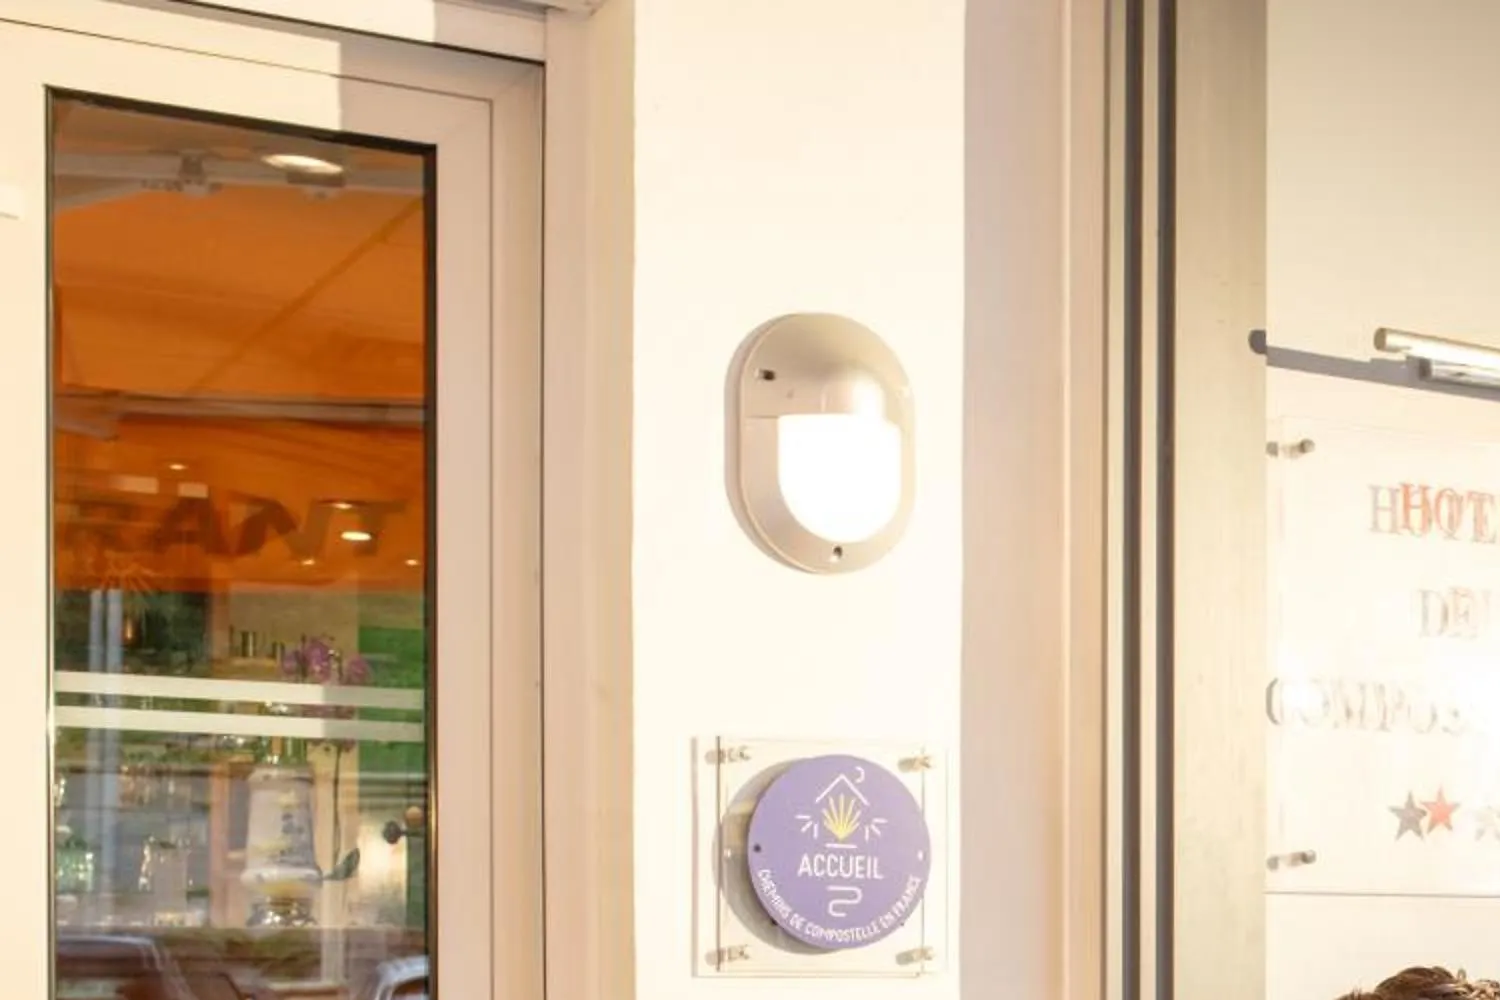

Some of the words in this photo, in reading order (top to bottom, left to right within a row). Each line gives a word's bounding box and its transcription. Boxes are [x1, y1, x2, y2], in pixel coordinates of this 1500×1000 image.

[797, 854, 883, 879] ACCUEIL
[757, 867, 793, 921] CHEMINS
[788, 912, 804, 931] DE
[803, 922, 881, 944] COMPOSTELLE
[878, 911, 896, 932] EN
[890, 874, 923, 922] FRANCE
